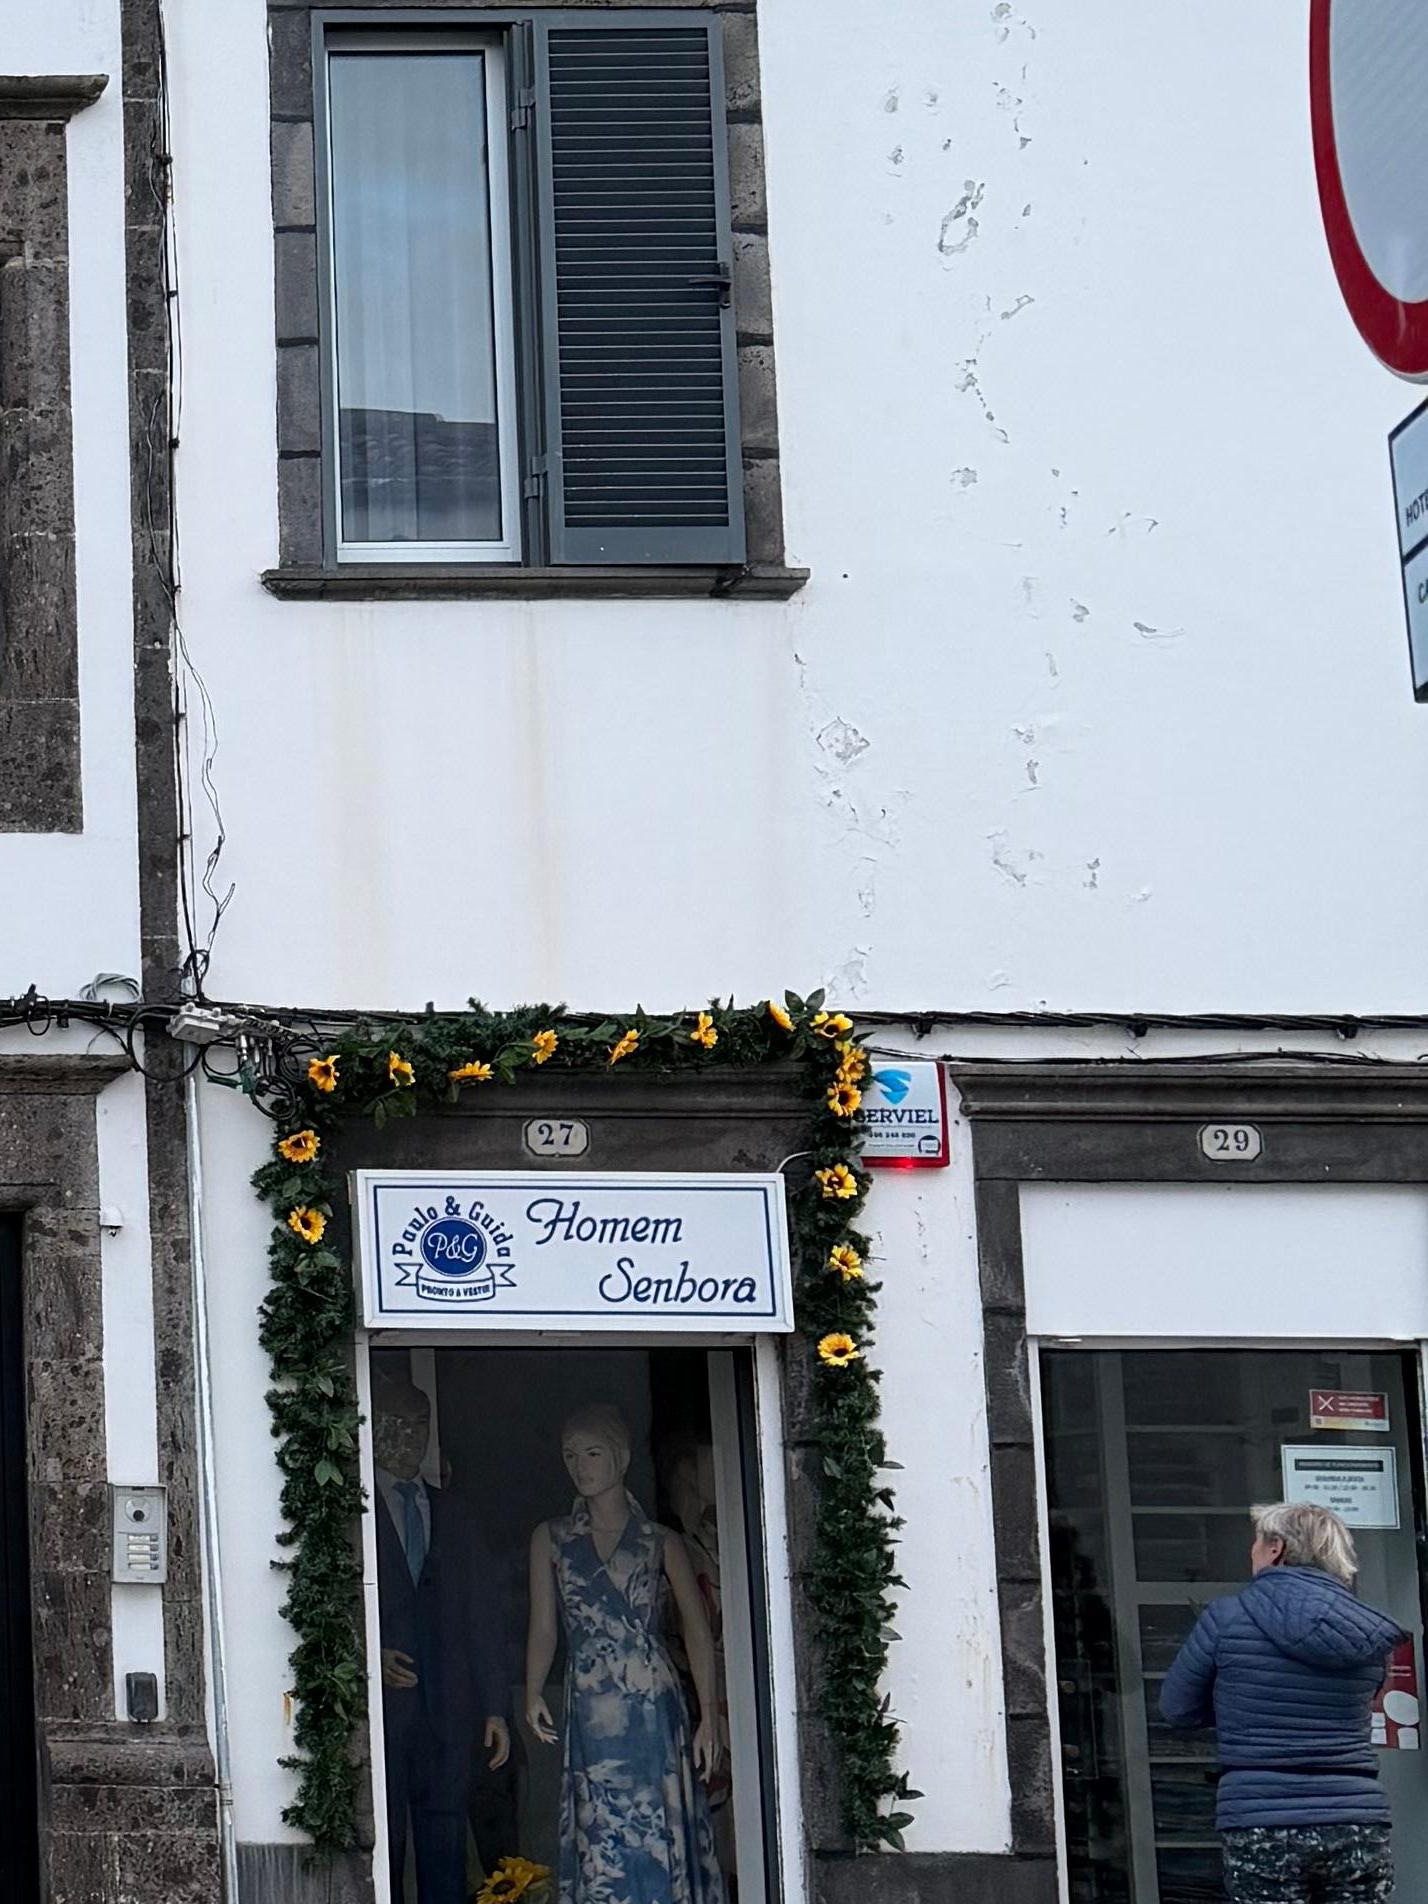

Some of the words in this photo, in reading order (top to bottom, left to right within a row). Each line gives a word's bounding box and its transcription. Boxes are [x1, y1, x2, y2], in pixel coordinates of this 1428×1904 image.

[537, 1123, 574, 1146] 27
[1213, 1128, 1249, 1152] 29
[392, 1206, 439, 1257] Paulo
[444, 1195, 461, 1216] &
[468, 1201, 514, 1258] Guida
[526, 1197, 683, 1245] Homem
[427, 1232, 478, 1263] P&G
[598, 1256, 757, 1304] Senhora
